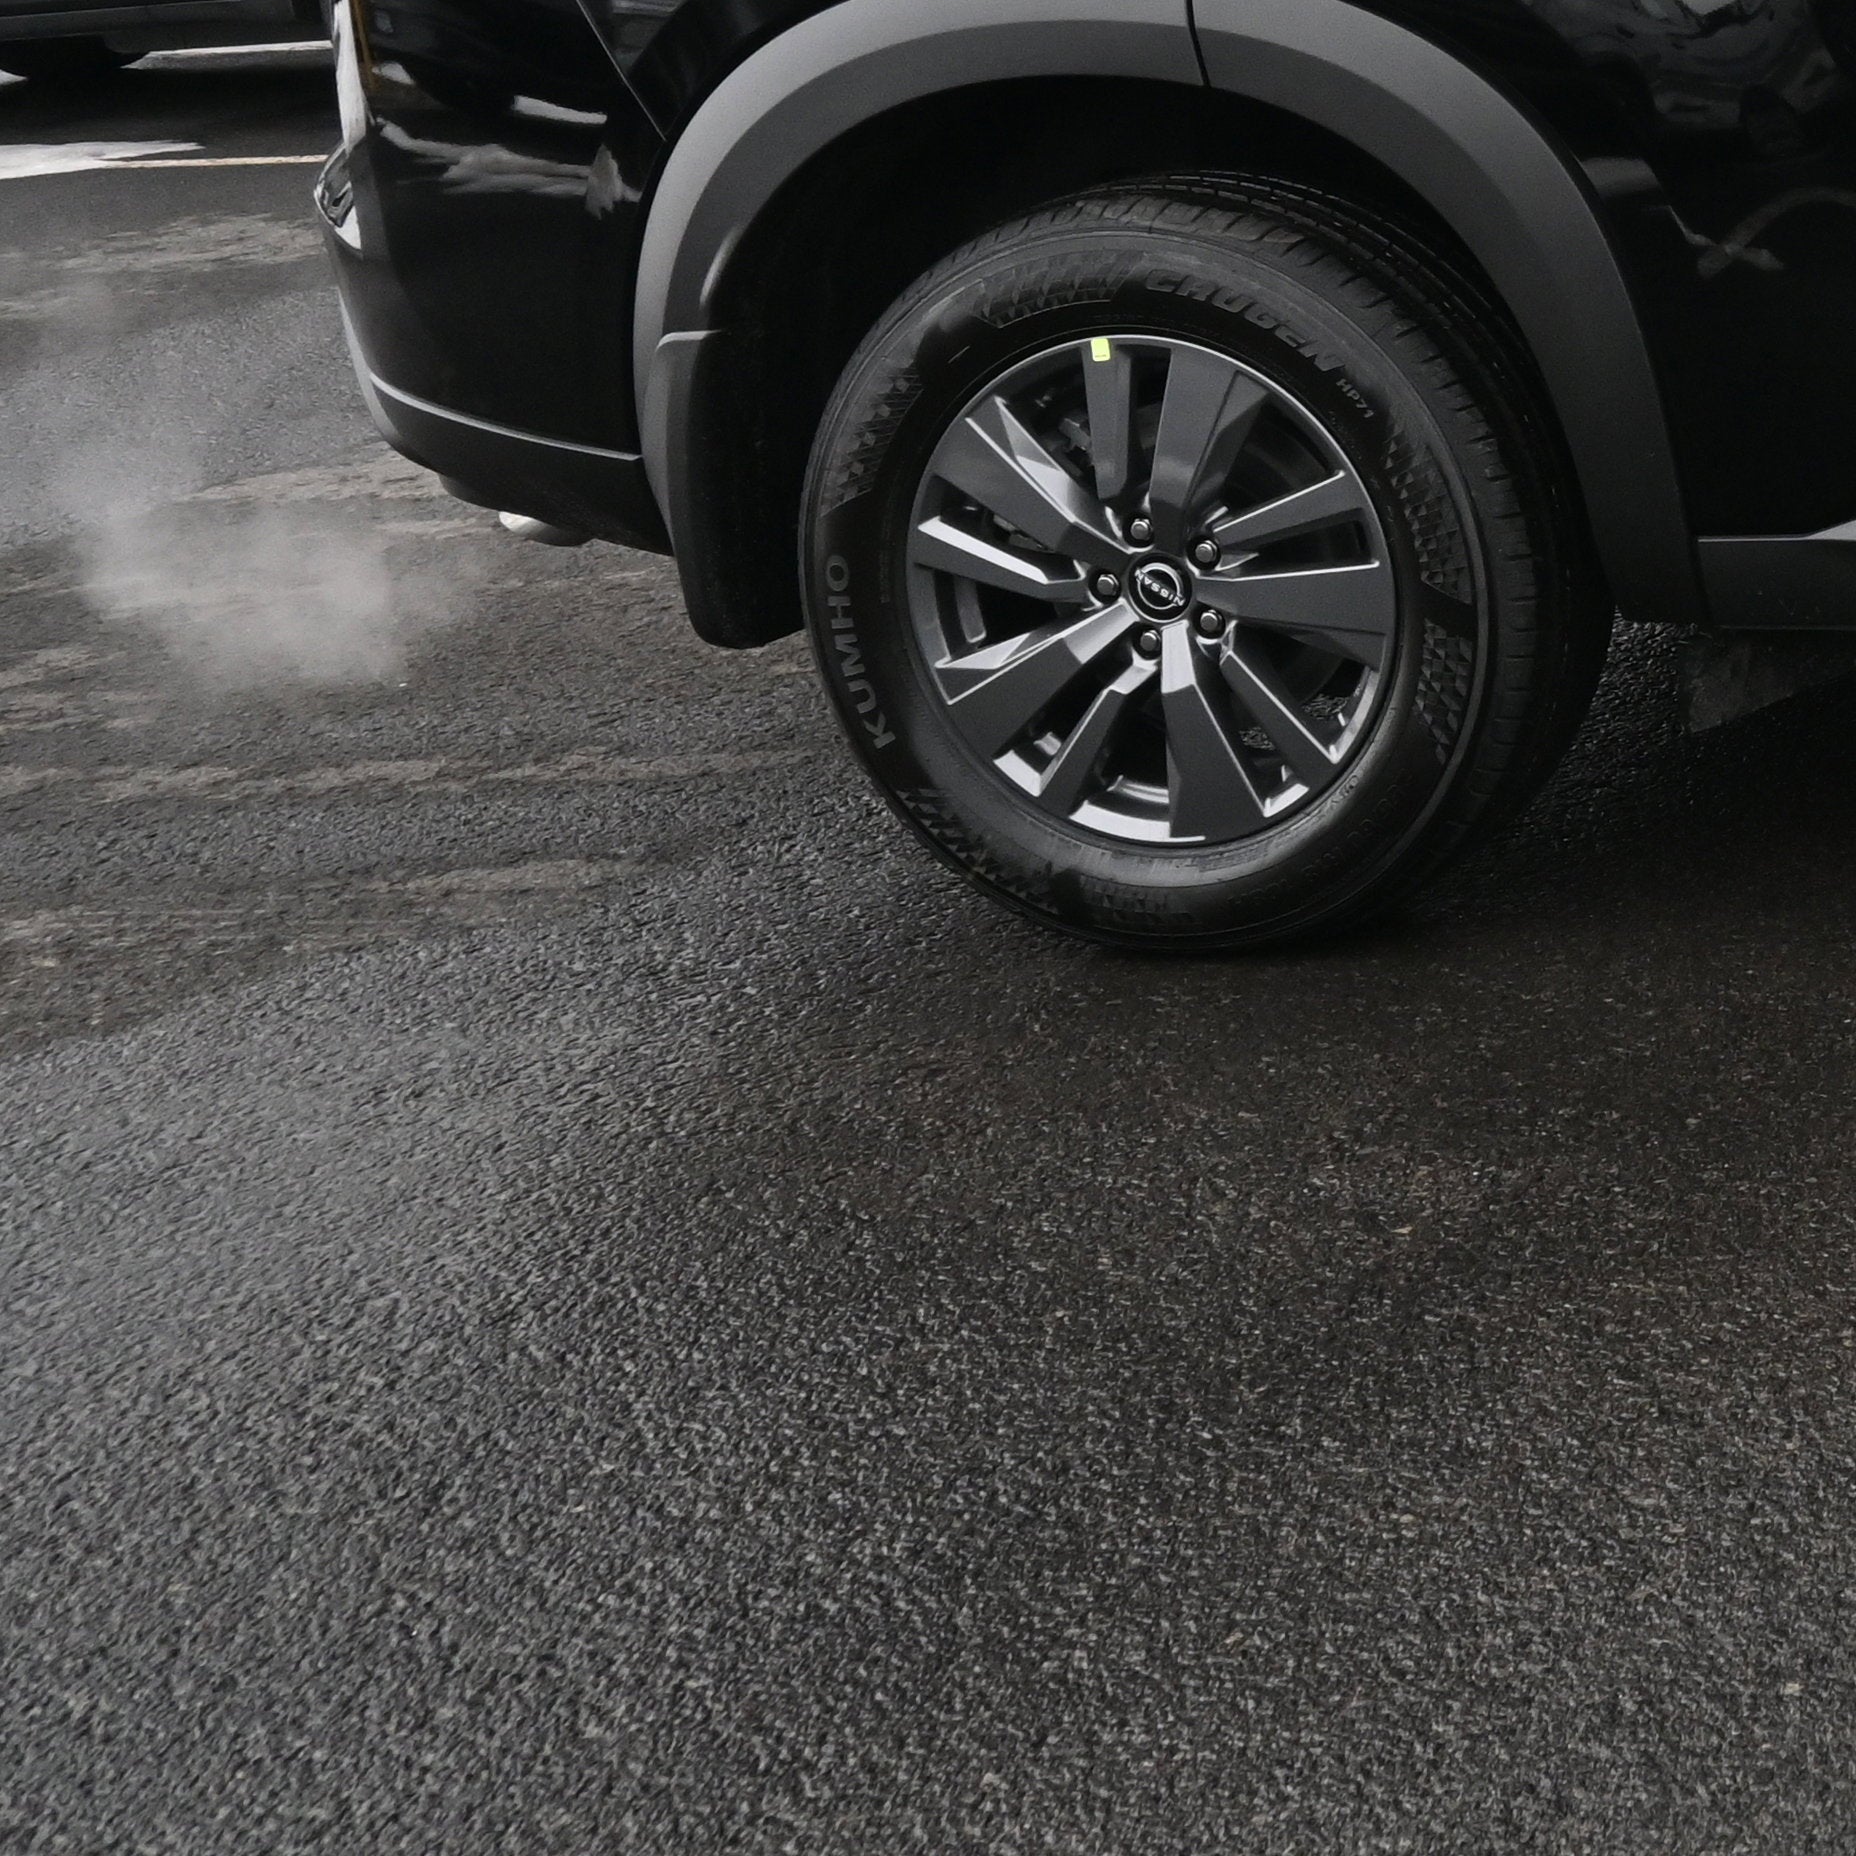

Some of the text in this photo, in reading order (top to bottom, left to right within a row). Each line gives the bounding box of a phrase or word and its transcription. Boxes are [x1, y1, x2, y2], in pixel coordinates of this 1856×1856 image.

[1145, 269, 1376, 419] CRUGEN HP71
[825, 554, 897, 750] KUMHO
[1134, 568, 1186, 607] NISSAN
